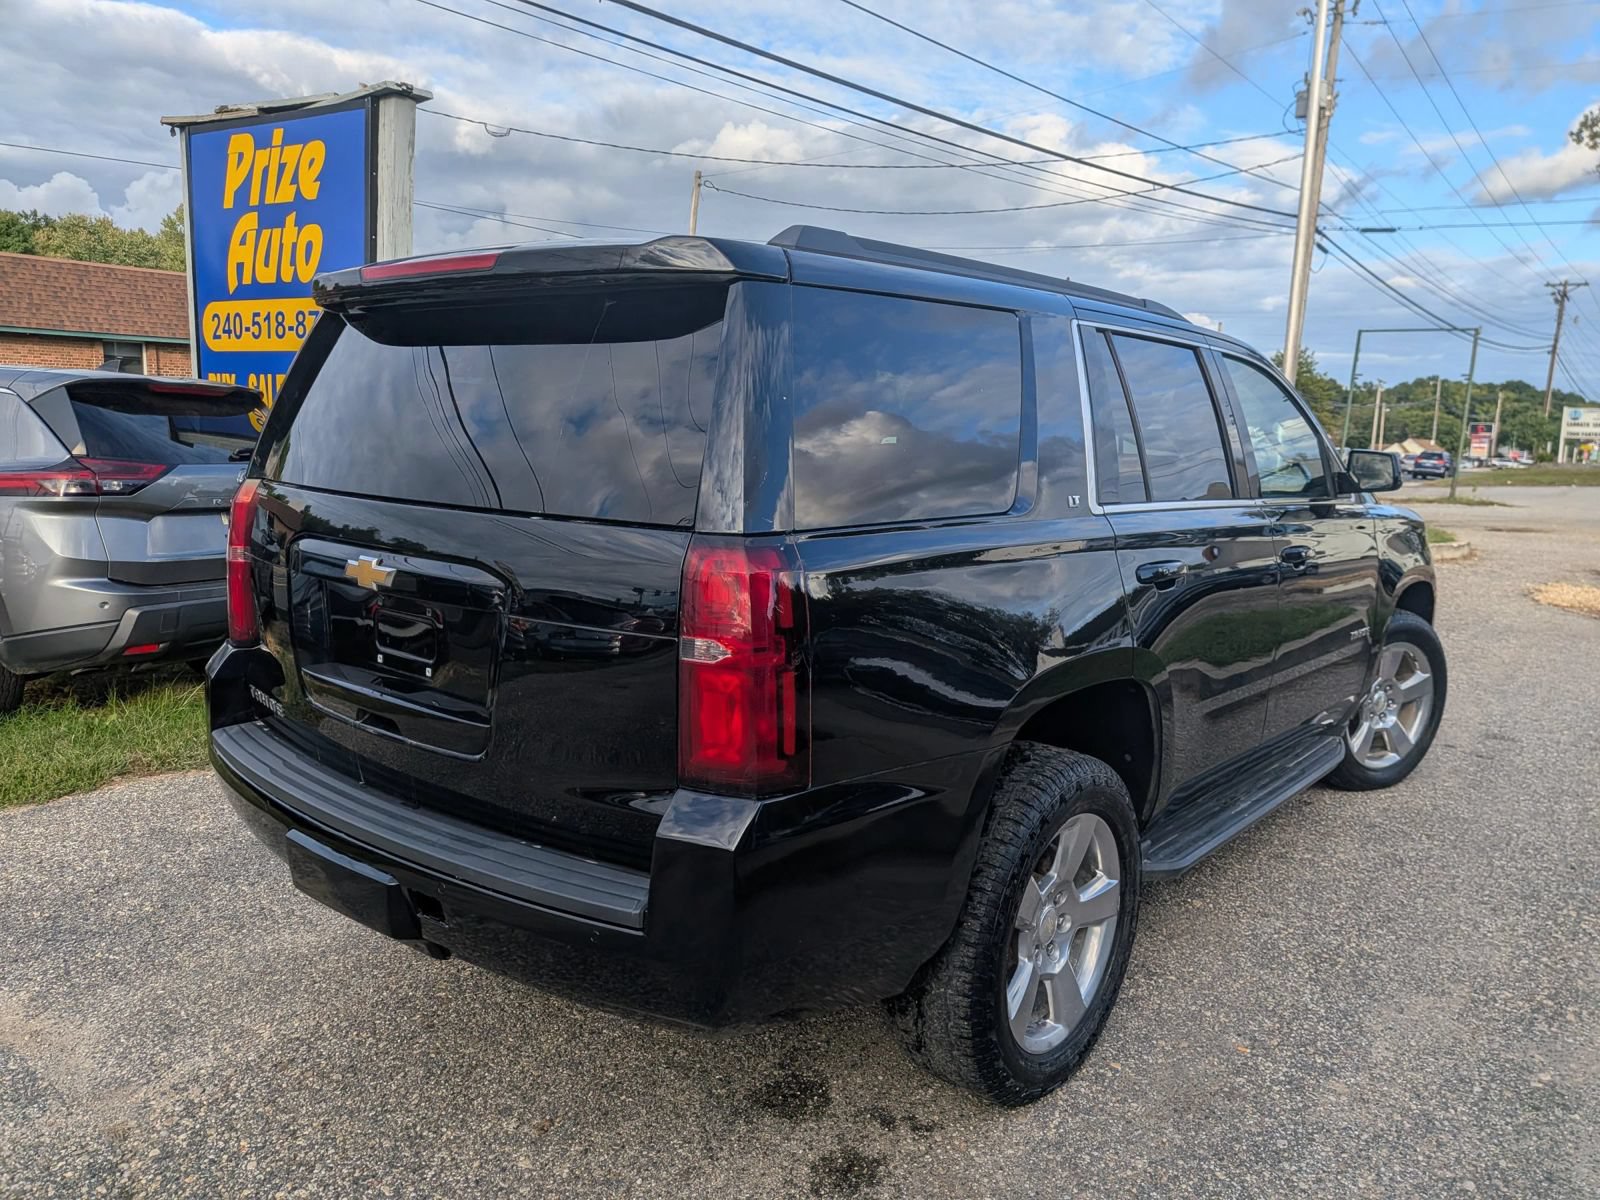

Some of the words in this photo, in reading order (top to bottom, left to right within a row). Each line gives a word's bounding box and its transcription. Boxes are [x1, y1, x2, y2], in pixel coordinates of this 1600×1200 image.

[224, 128, 326, 209] Prize
[227, 211, 323, 295] Auto
[1068, 495, 1080, 508] LT
